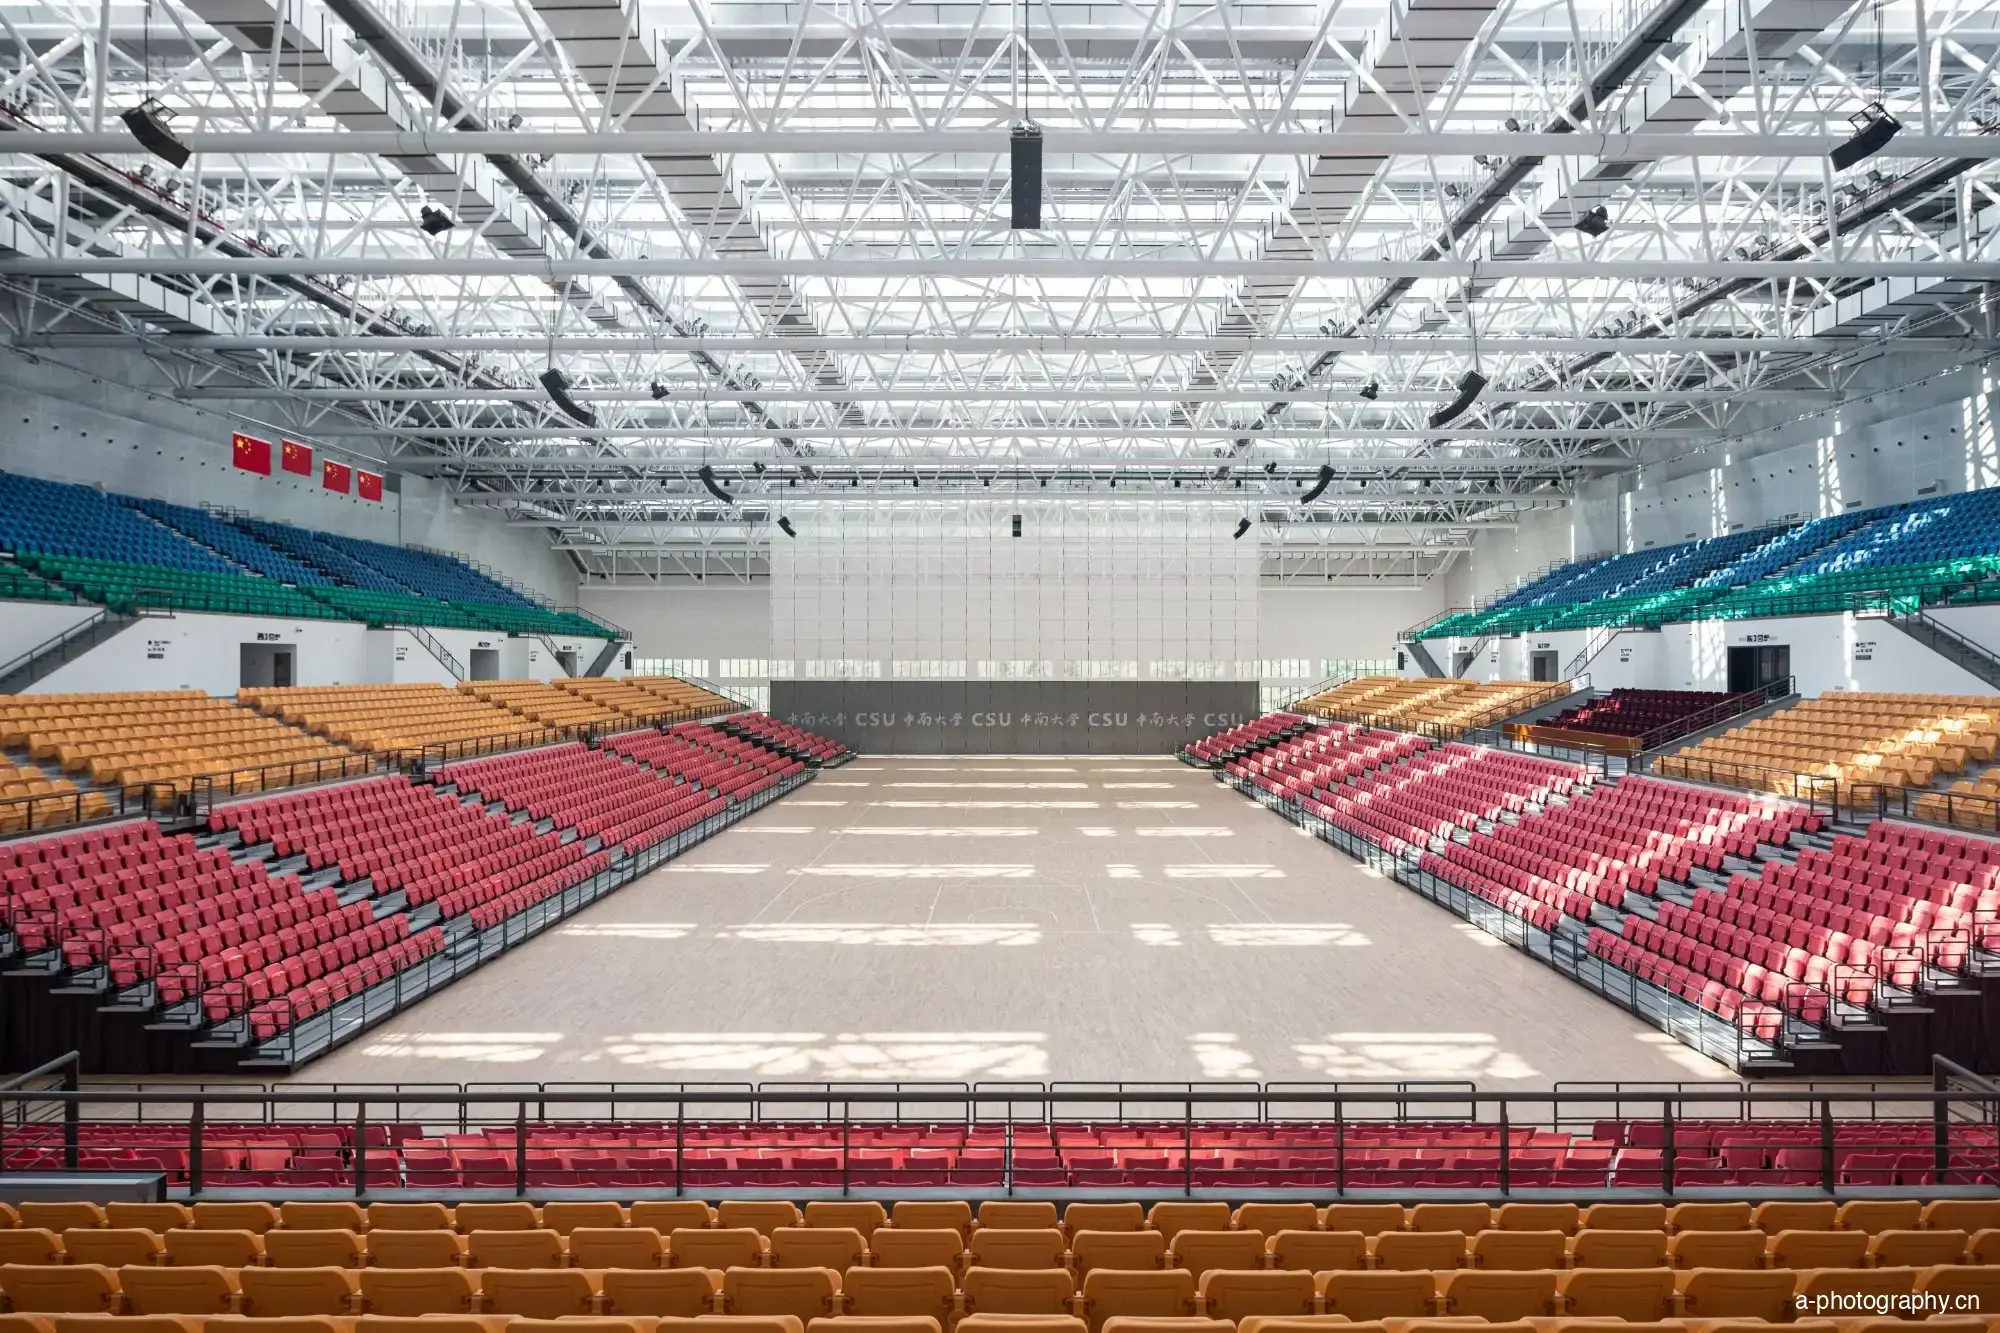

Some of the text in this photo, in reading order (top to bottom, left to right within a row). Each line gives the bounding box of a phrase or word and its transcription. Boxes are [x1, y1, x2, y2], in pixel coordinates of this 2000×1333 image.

[855, 712, 895, 727] CSU
[971, 712, 1011, 727] CSU
[1089, 712, 1128, 727] CSU
[1204, 712, 1244, 727] CSU
